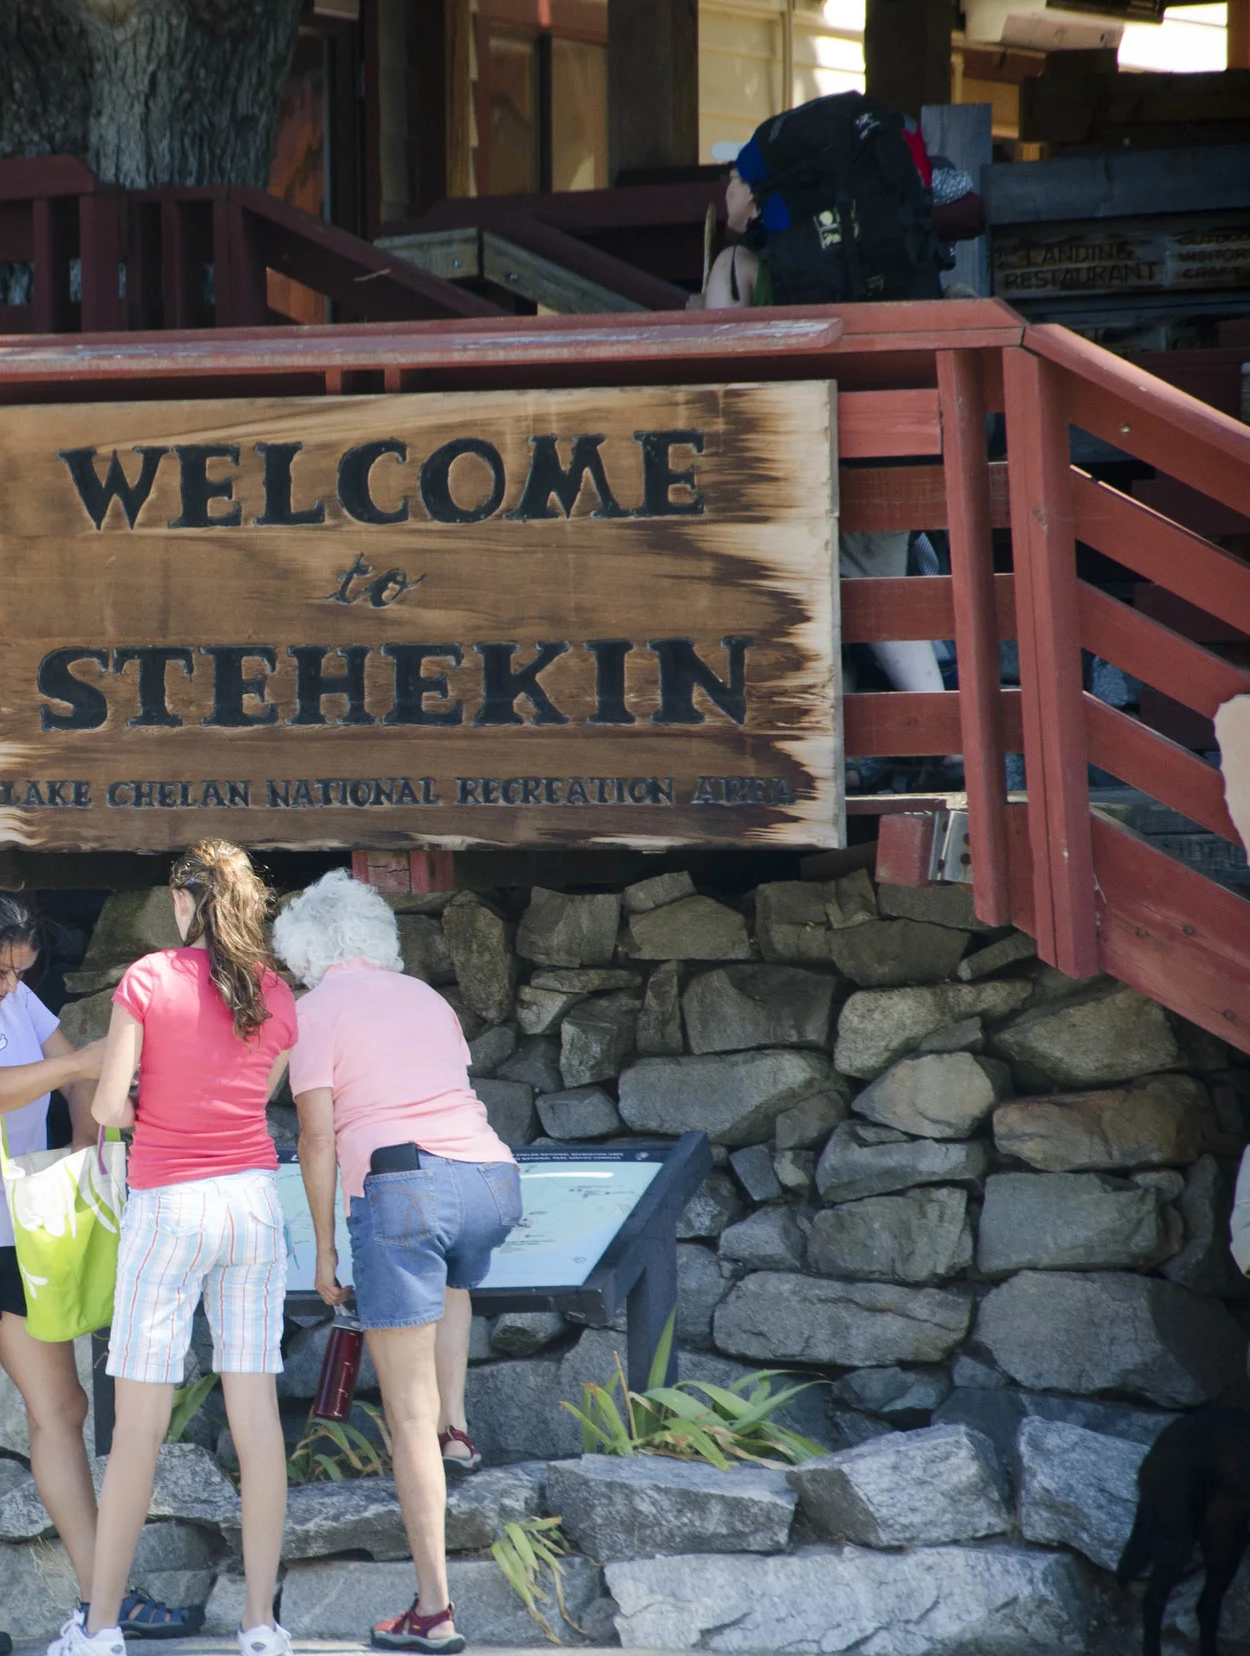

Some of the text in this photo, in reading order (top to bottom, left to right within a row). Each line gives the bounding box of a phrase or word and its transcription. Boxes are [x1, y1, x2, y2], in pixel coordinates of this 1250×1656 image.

[1003, 261, 1159, 290] RESTAURANT
[58, 430, 705, 530] WELCOME
[327, 553, 427, 608] to
[38, 637, 754, 731] STEHEKIN
[0, 775, 794, 808] LAKE CHELAN NATIONAL RECREATION AREA
